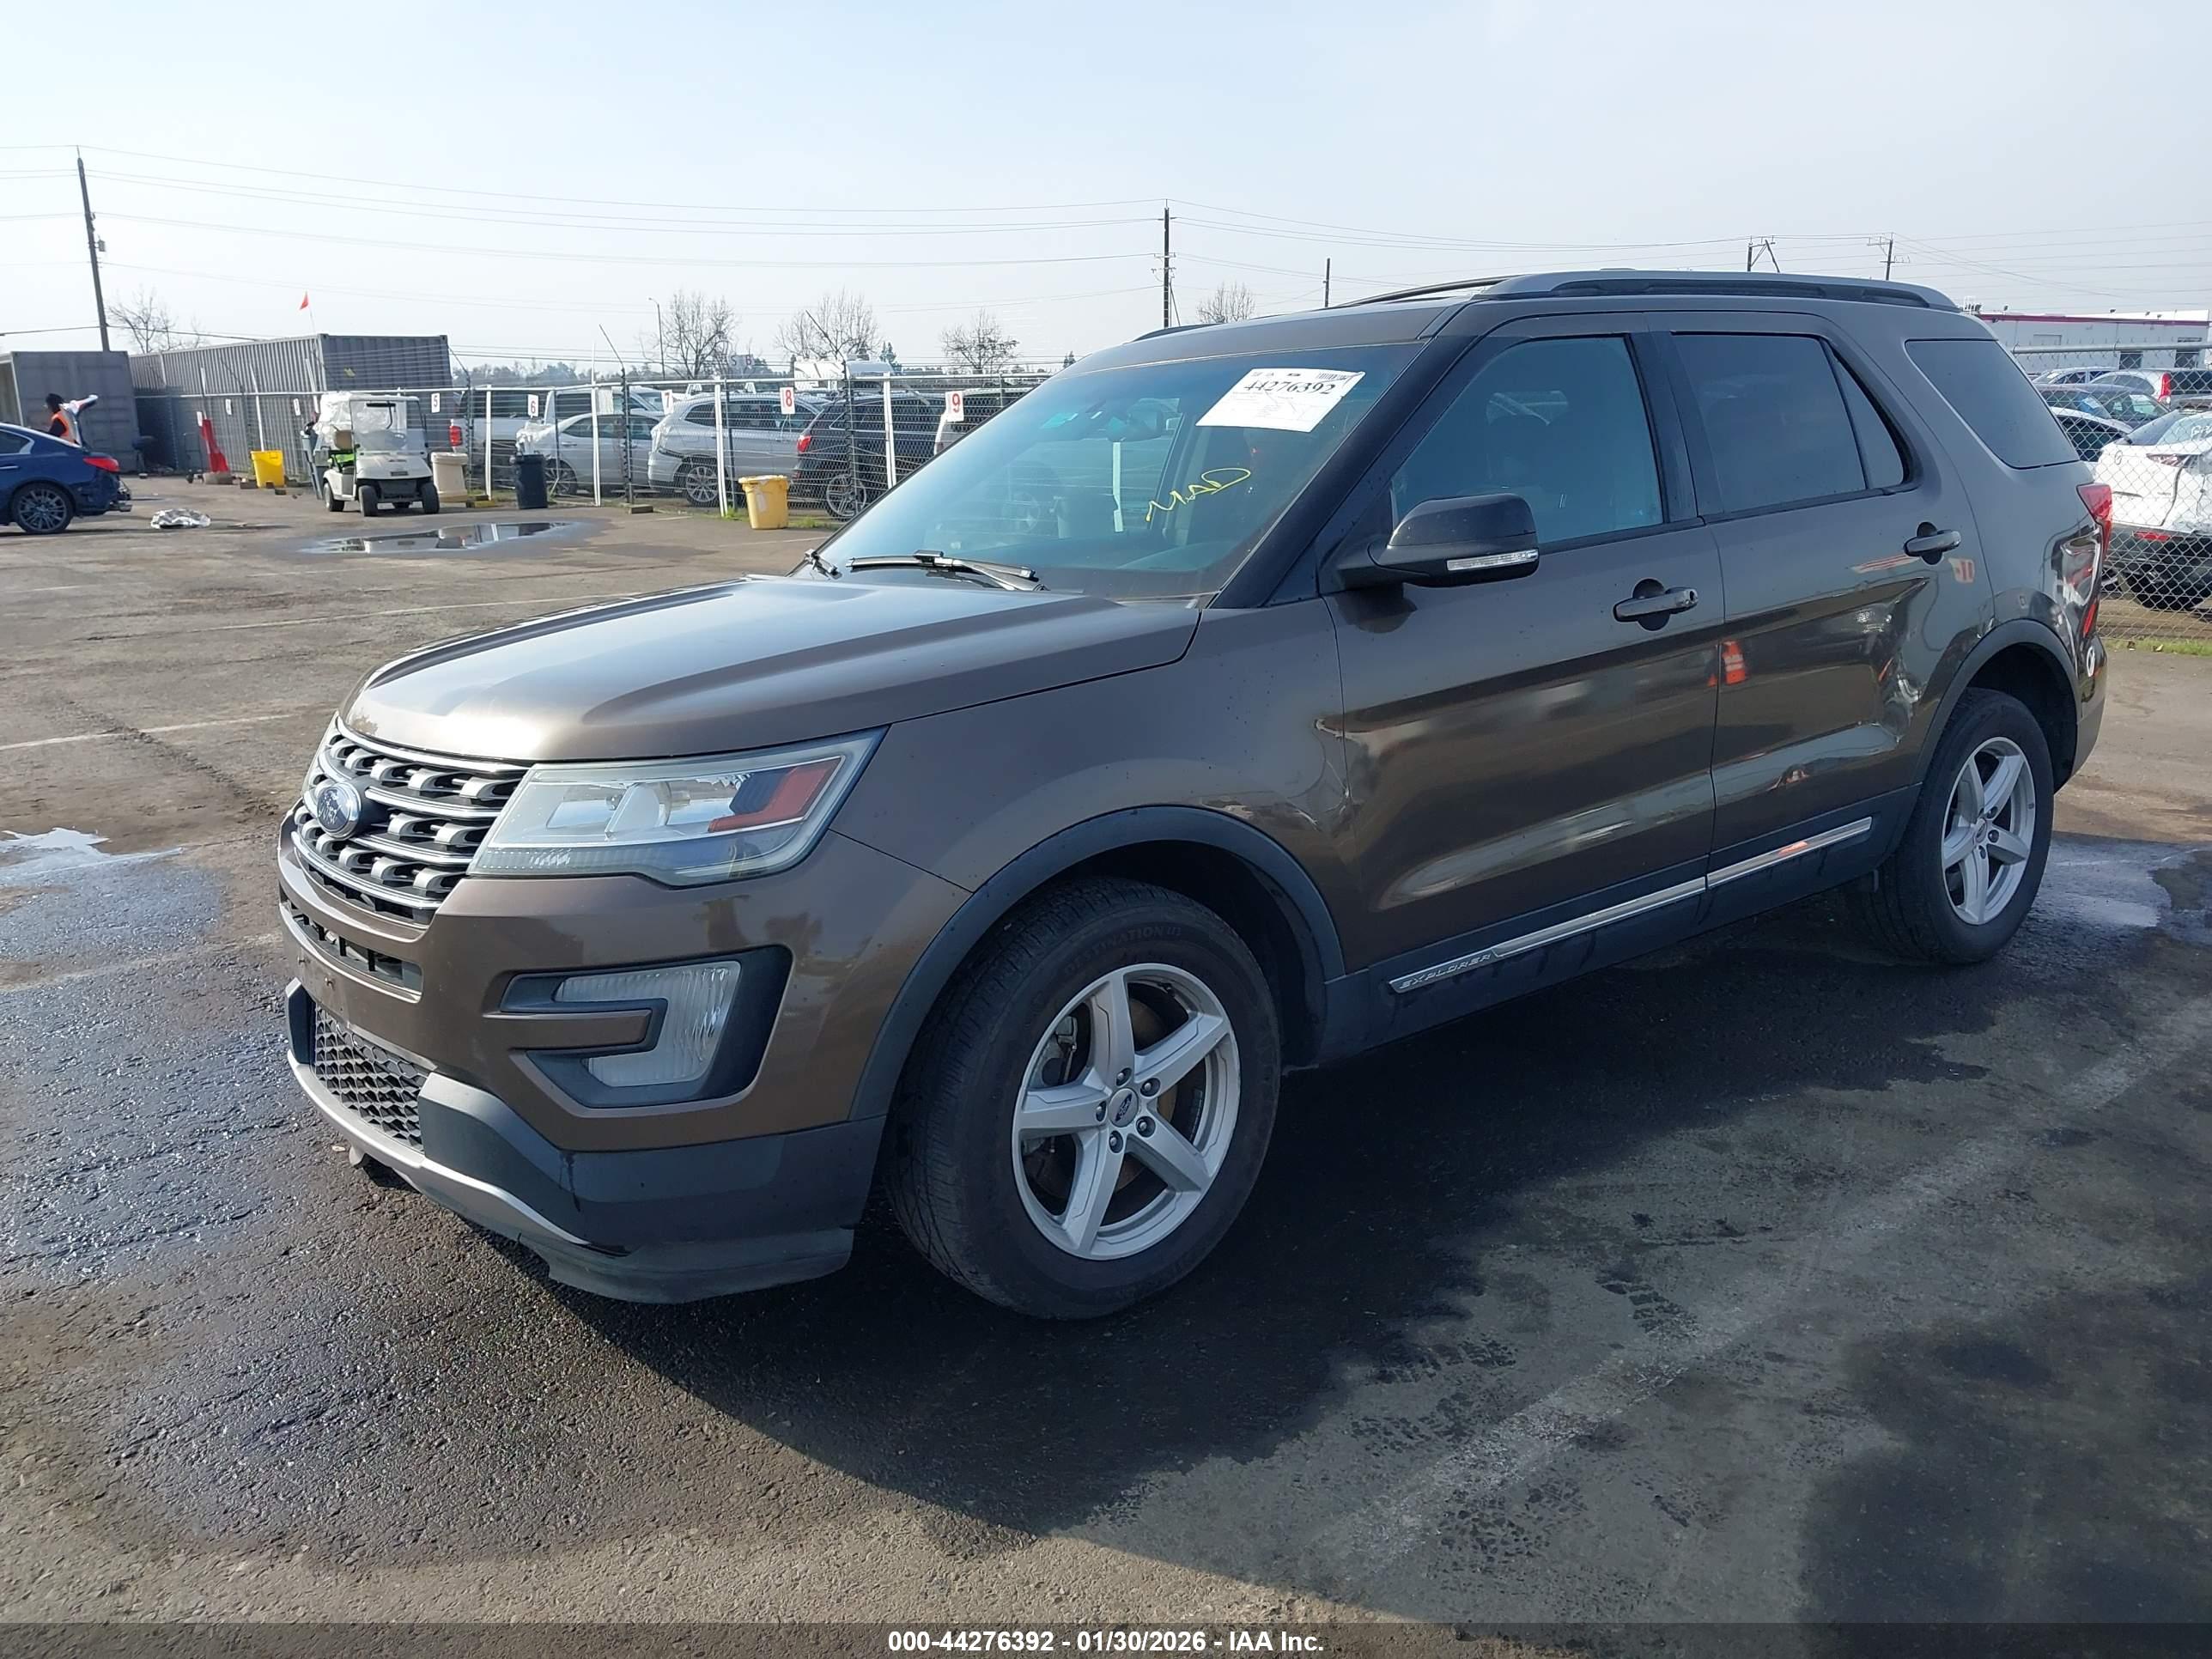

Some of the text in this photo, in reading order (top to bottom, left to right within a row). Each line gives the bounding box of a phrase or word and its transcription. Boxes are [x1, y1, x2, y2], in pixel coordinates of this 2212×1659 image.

[1243, 380, 1336, 395] 44276392
[433, 395, 438, 407] 5
[664, 392, 670, 408] 7
[785, 389, 793, 407] 8
[952, 393, 960, 413] 9
[531, 400, 536, 414] 6
[1399, 953, 1492, 989] EXPLORER
